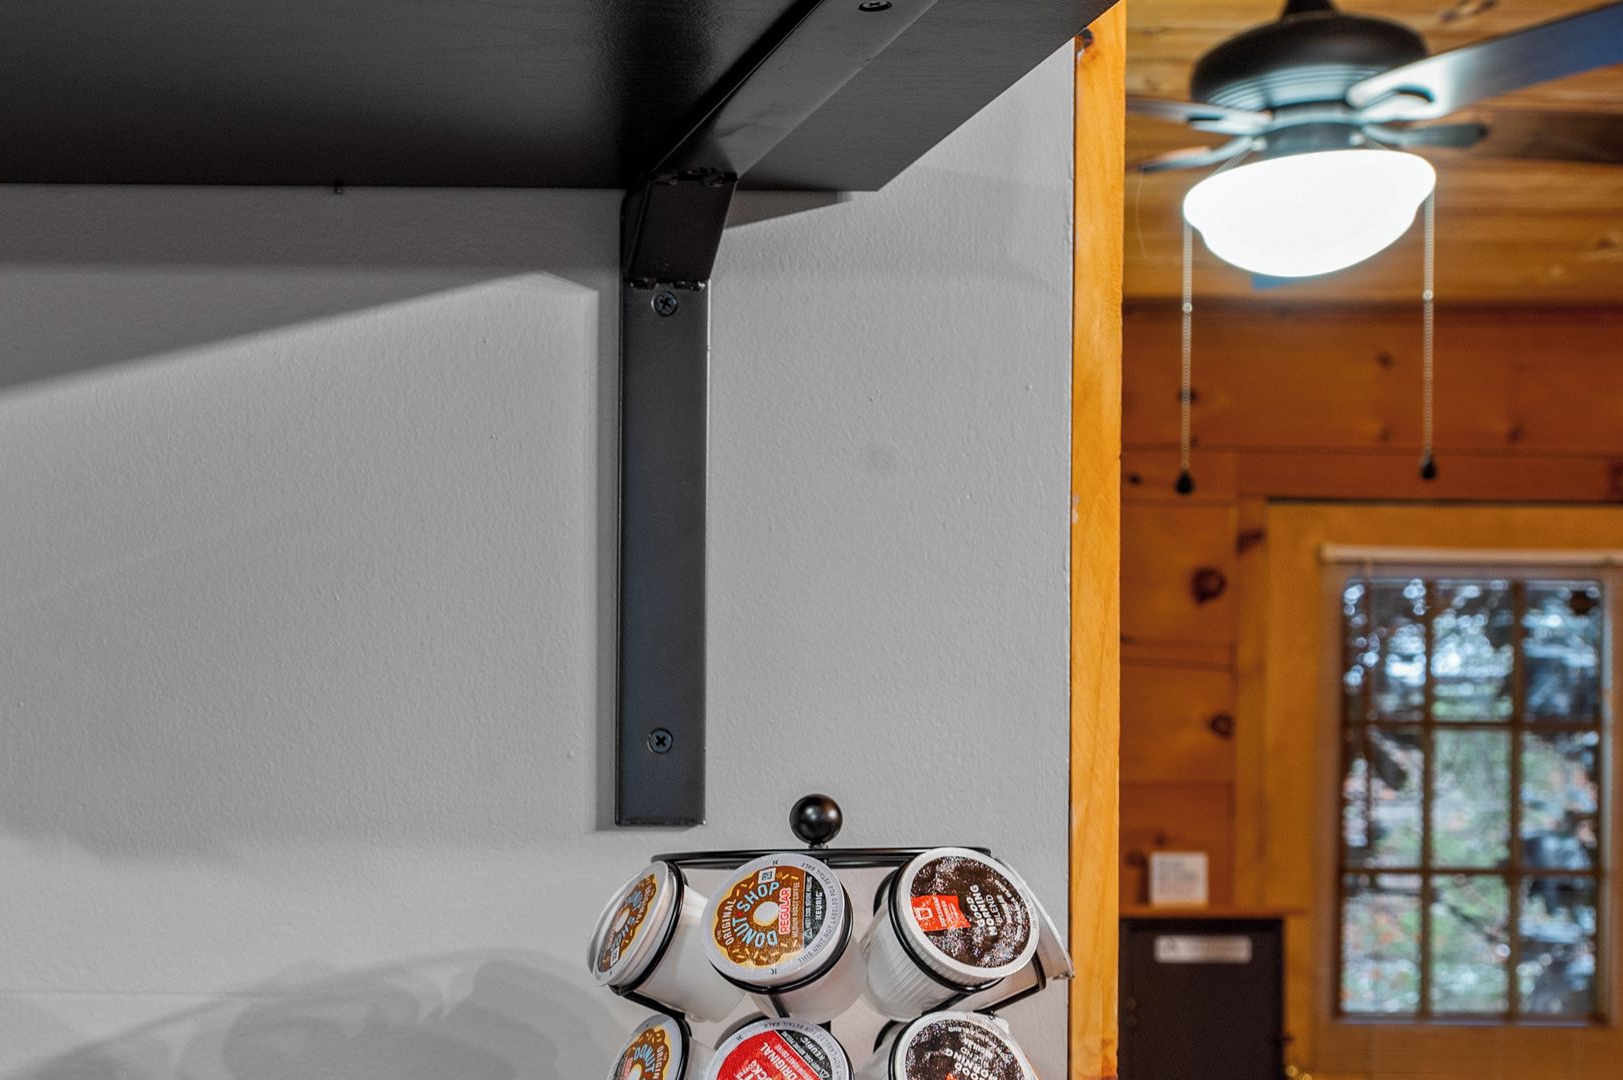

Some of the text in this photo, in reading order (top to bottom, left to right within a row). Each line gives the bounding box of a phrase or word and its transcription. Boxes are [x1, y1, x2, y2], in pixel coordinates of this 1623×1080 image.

[722, 899, 737, 945] ORIGINAL
[732, 881, 780, 948] DONUT SHOP
[778, 887, 792, 935] REGULAR
[967, 897, 985, 927] GOOD
[970, 884, 997, 936] MORNING
[986, 895, 1003, 926] BLEND
[633, 1044, 655, 1073] DONUT
[800, 1034, 825, 1061] KEURIG
